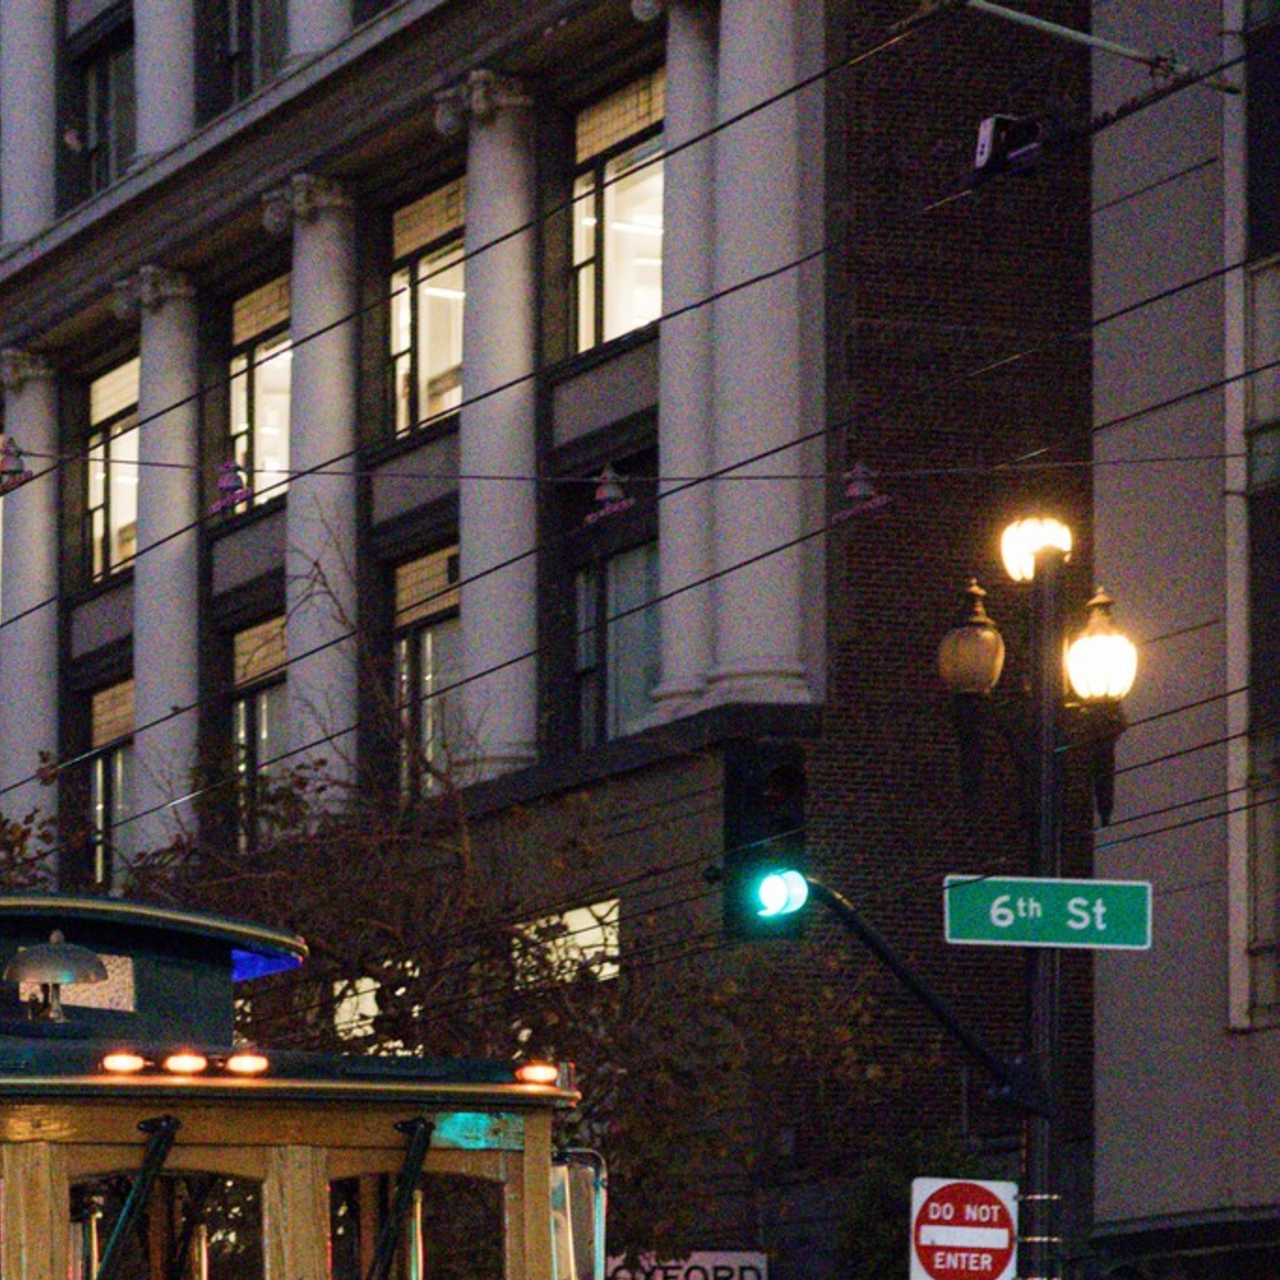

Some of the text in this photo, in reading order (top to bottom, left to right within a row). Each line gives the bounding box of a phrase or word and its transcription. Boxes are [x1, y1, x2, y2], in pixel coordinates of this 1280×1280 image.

[989, 894, 1107, 931] 6th St
[928, 1202, 1001, 1222] DO NOT
[933, 1251, 994, 1271] ENTER
